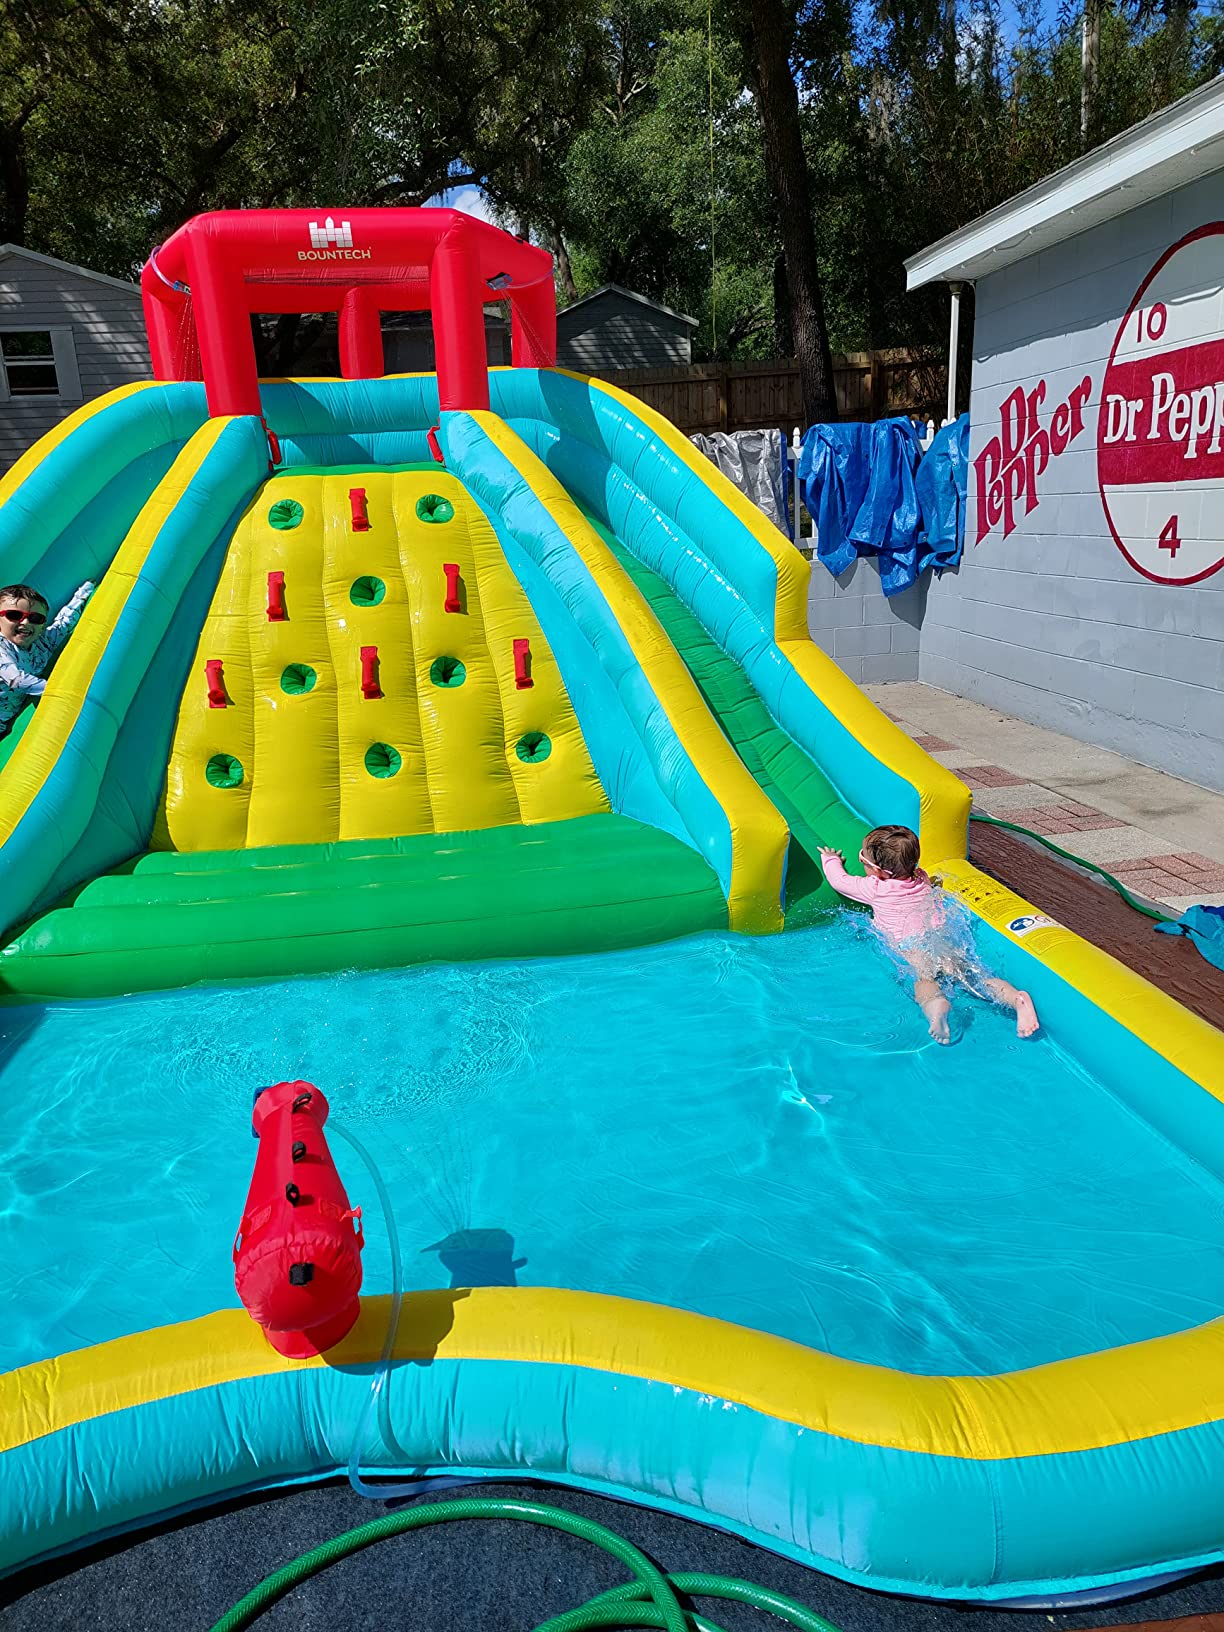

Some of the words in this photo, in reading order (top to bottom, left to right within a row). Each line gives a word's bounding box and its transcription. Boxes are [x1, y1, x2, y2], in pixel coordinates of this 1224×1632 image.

[297, 249, 371, 260] BOUNTECH
[1137, 302, 1167, 343] 10
[999, 379, 1046, 459] Dr
[1103, 394, 1143, 444] Dr
[973, 375, 1092, 548] Pepper
[1158, 515, 1181, 558] 4
